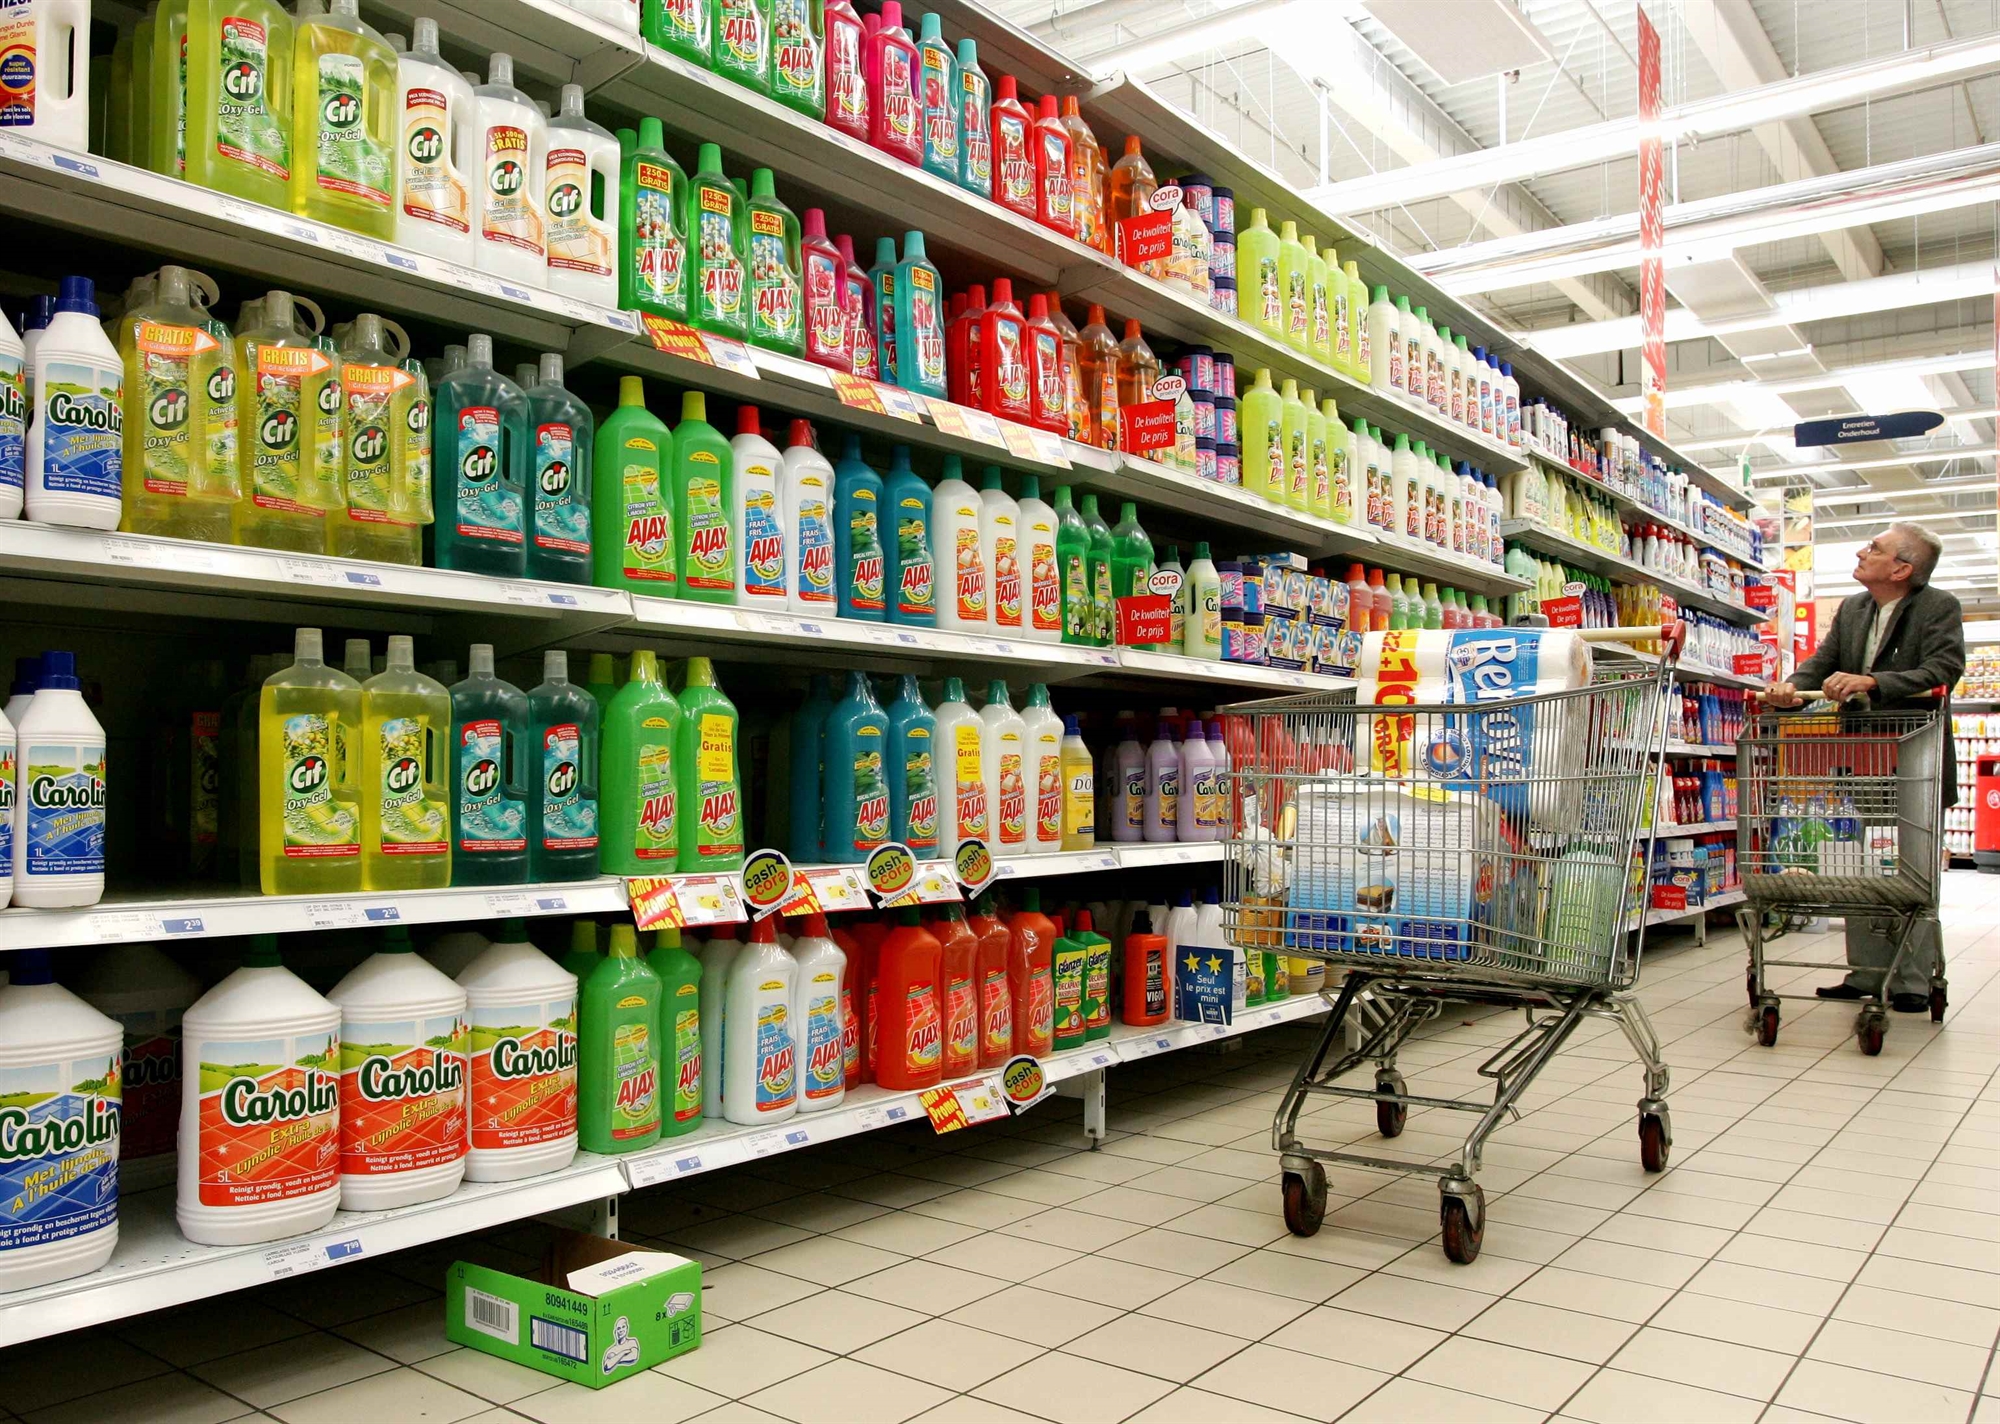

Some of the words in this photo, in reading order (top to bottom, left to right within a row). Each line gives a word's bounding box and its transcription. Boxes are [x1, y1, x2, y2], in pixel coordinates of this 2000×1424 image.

[778, 42, 814, 74] AJAX
[4, 66, 31, 74] résistant
[226, 65, 258, 94] Cif
[220, 104, 264, 116] Oxy-Gel
[325, 95, 357, 123] Cif
[321, 129, 362, 143] Oxy-Gel
[410, 130, 440, 158] Cif
[489, 138, 527, 152] GRATIS
[492, 163, 521, 191] Cif
[641, 176, 668, 190] GRATIS
[1003, 161, 1030, 184] AJAX
[550, 187, 579, 213] Cif
[702, 199, 729, 214] GRATIS
[1153, 188, 1179, 203] cora
[754, 222, 782, 234] GRATIS
[1132, 228, 1143, 241] De
[1142, 222, 1172, 239] kwaliteit
[1138, 243, 1148, 256] De
[1149, 241, 1166, 256] prijs
[757, 287, 793, 316] AJAX
[144, 325, 193, 346] GRATIS
[262, 349, 309, 366] GRATIS
[208, 370, 235, 399] Cif
[347, 367, 390, 383] GRATIS
[1155, 378, 1182, 392] cora
[319, 381, 341, 410] Cif
[151, 392, 188, 425] Cif
[407, 403, 429, 428] Cif
[1134, 416, 1145, 429] De
[1144, 411, 1175, 427] kwaliteit
[262, 413, 297, 444] Cif
[1837, 428, 1880, 438] Onderhoud
[1842, 420, 1875, 429] Entretien
[353, 428, 388, 458] Cif
[1140, 432, 1151, 444] De
[1151, 429, 1169, 445] prijs
[256, 449, 300, 467] Oxy-Gel
[464, 448, 493, 478] Cif
[350, 463, 391, 481] Oxy-Gel
[541, 464, 567, 492] Cif
[460, 482, 499, 498] Oxy-Gel
[538, 495, 572, 511] Oxy-Gel
[626, 515, 669, 546] AJAX
[749, 519, 767, 528] FRAIS
[749, 527, 763, 537] FRIS
[802, 528, 820, 538] FRAIS
[689, 526, 728, 556] AJAX
[748, 535, 784, 565] AJAX
[802, 537, 816, 546] FRIS
[802, 544, 833, 573] AJAX
[854, 559, 884, 585] AJAX
[901, 562, 932, 591] AJAX
[1151, 574, 1179, 586] cora
[960, 573, 986, 598] AJAX
[1034, 587, 1060, 610] AJAX
[1130, 609, 1141, 621] De
[1140, 607, 1171, 621] kwaliteit
[1136, 625, 1147, 637] De
[1147, 623, 1165, 639] prijs
[702, 740, 732, 753] Gratis
[957, 747, 981, 758] Gratis
[291, 758, 323, 789] Cif
[387, 760, 417, 788] Cif
[467, 762, 495, 794] Cif
[550, 764, 575, 794] Cif
[287, 789, 329, 811] Oxy-Gel
[384, 791, 421, 810] Oxy-Gel
[464, 792, 501, 814] Oxy-Gel
[547, 793, 579, 814] Oxy-Gel
[639, 792, 677, 828] AJAX
[699, 790, 737, 827] AJAX
[858, 796, 889, 826] AJAX
[910, 796, 937, 827] AJAX
[959, 795, 987, 825] AJAX
[869, 854, 903, 880] cash
[957, 848, 982, 874] cash
[966, 853, 990, 879] cora
[745, 863, 778, 890] cash
[755, 870, 788, 897] cora
[879, 862, 912, 886] cora
[1185, 984, 1194, 992] le
[1195, 984, 1211, 995] prix
[1213, 987, 1226, 995] est
[1197, 974, 1215, 984] Seul
[1146, 988, 1165, 1003] VIGOR
[1200, 994, 1219, 1004] mini
[760, 1034, 780, 1046] FRAIS
[810, 1025, 829, 1037] FRAIS
[810, 1034, 824, 1045] FRIS
[908, 1021, 940, 1054] AJAX
[493, 1031, 578, 1079] Carolin
[760, 1044, 775, 1055] FRIS
[809, 1037, 842, 1072] AJAX
[759, 1044, 794, 1083] AJAX
[360, 1051, 463, 1101] Carolin
[529, 1076, 561, 1095] Extra
[616, 1065, 656, 1108] AJAX
[1005, 1066, 1032, 1089] cash
[1014, 1073, 1041, 1094] cora
[224, 1069, 338, 1125] Carolin
[403, 1098, 438, 1118] Extra
[503, 1096, 540, 1123] Lijnolie
[930, 1097, 959, 1123] Promo
[0, 1098, 118, 1159] Carolin
[269, 1120, 311, 1144] Extra
[371, 1119, 412, 1147] Lijnolie
[419, 1107, 439, 1121] Huile
[488, 1117, 500, 1129] 5L
[236, 1144, 281, 1176] Lijnolie
[289, 1130, 313, 1147] Huile
[354, 1141, 368, 1153] 5L
[365, 1153, 388, 1164] Reinigt
[24, 1166, 55, 1190] Met
[60, 1148, 105, 1172] lijnolie
[217, 1170, 232, 1183] 5L
[370, 1162, 393, 1172] Nettoie
[11, 1197, 25, 1214] A
[28, 1170, 77, 1203] l'huile
[80, 1161, 96, 1175] de
[229, 1186, 255, 1194] Reinigt
[255, 1182, 284, 1193] grondig,
[285, 1178, 302, 1188] voedt
[234, 1194, 260, 1203] Nettoie
[13, 1225, 43, 1237] grondig
[56, 1213, 90, 1227] beschermt
[22, 1234, 40, 1243] fond
[51, 1227, 78, 1241] protège
[545, 1292, 588, 1317] 80941449
